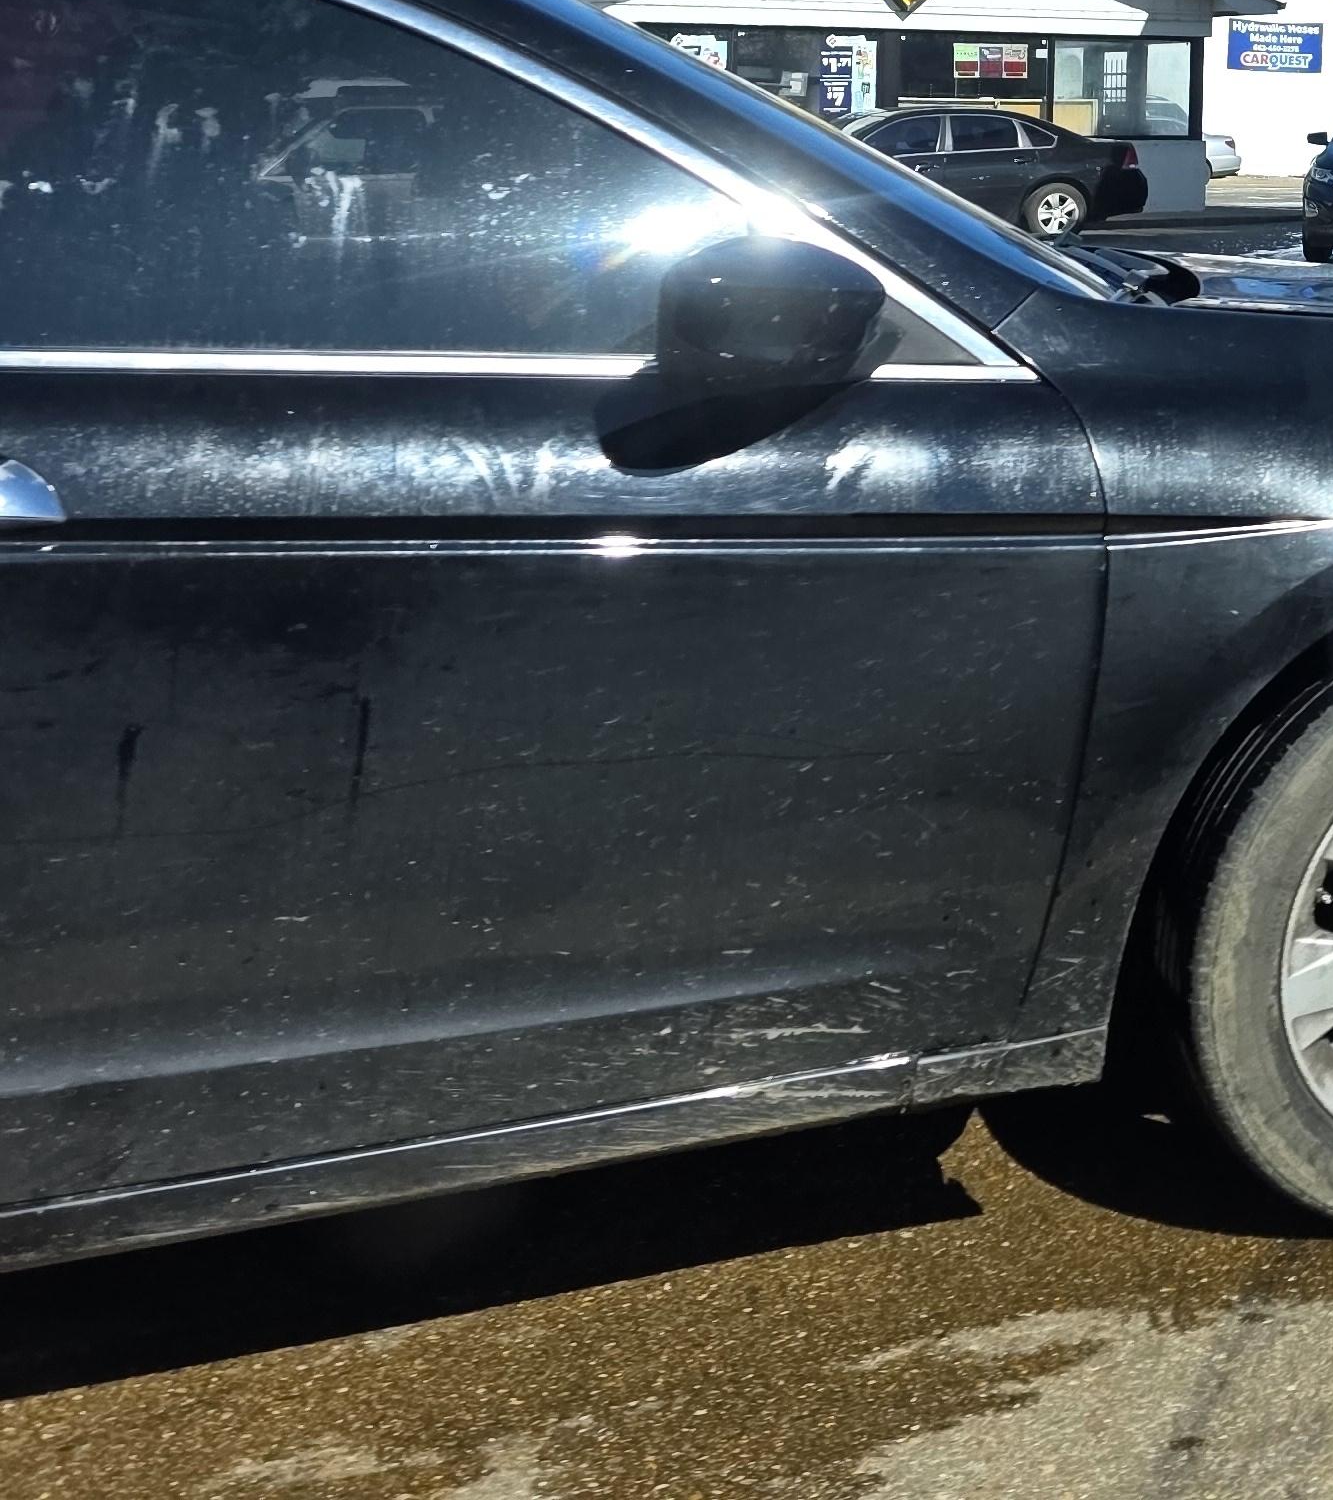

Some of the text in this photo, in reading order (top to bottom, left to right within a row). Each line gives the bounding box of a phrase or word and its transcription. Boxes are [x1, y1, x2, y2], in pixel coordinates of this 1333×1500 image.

[1232, 21, 1319, 34] Hydraulic Hoses
[1250, 33, 1303, 44] Made Here
[1242, 54, 1310, 67] CARQUEST
